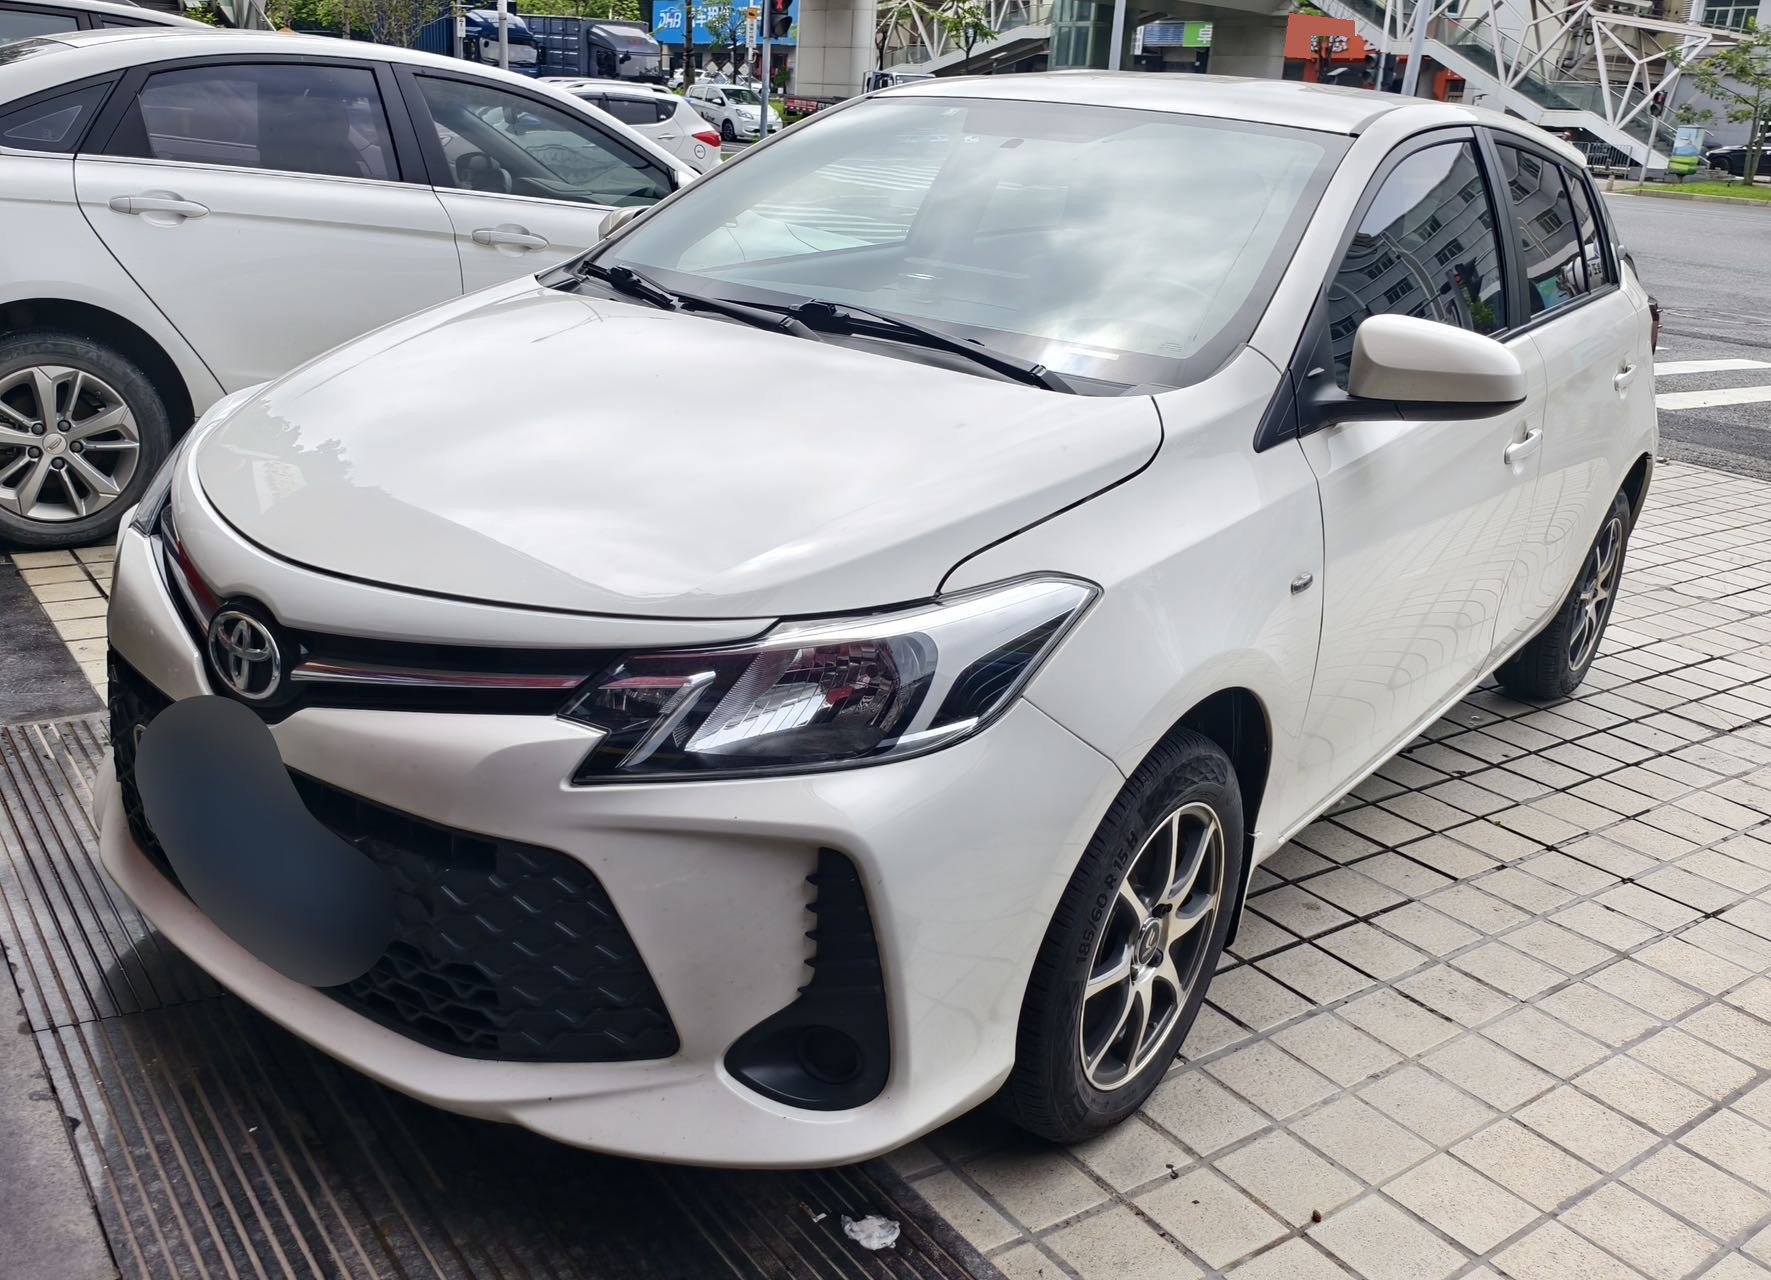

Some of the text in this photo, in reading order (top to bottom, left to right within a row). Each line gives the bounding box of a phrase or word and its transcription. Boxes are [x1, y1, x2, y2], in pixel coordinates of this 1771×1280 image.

[1076, 830, 1139, 964] 185/60 R 15 H
